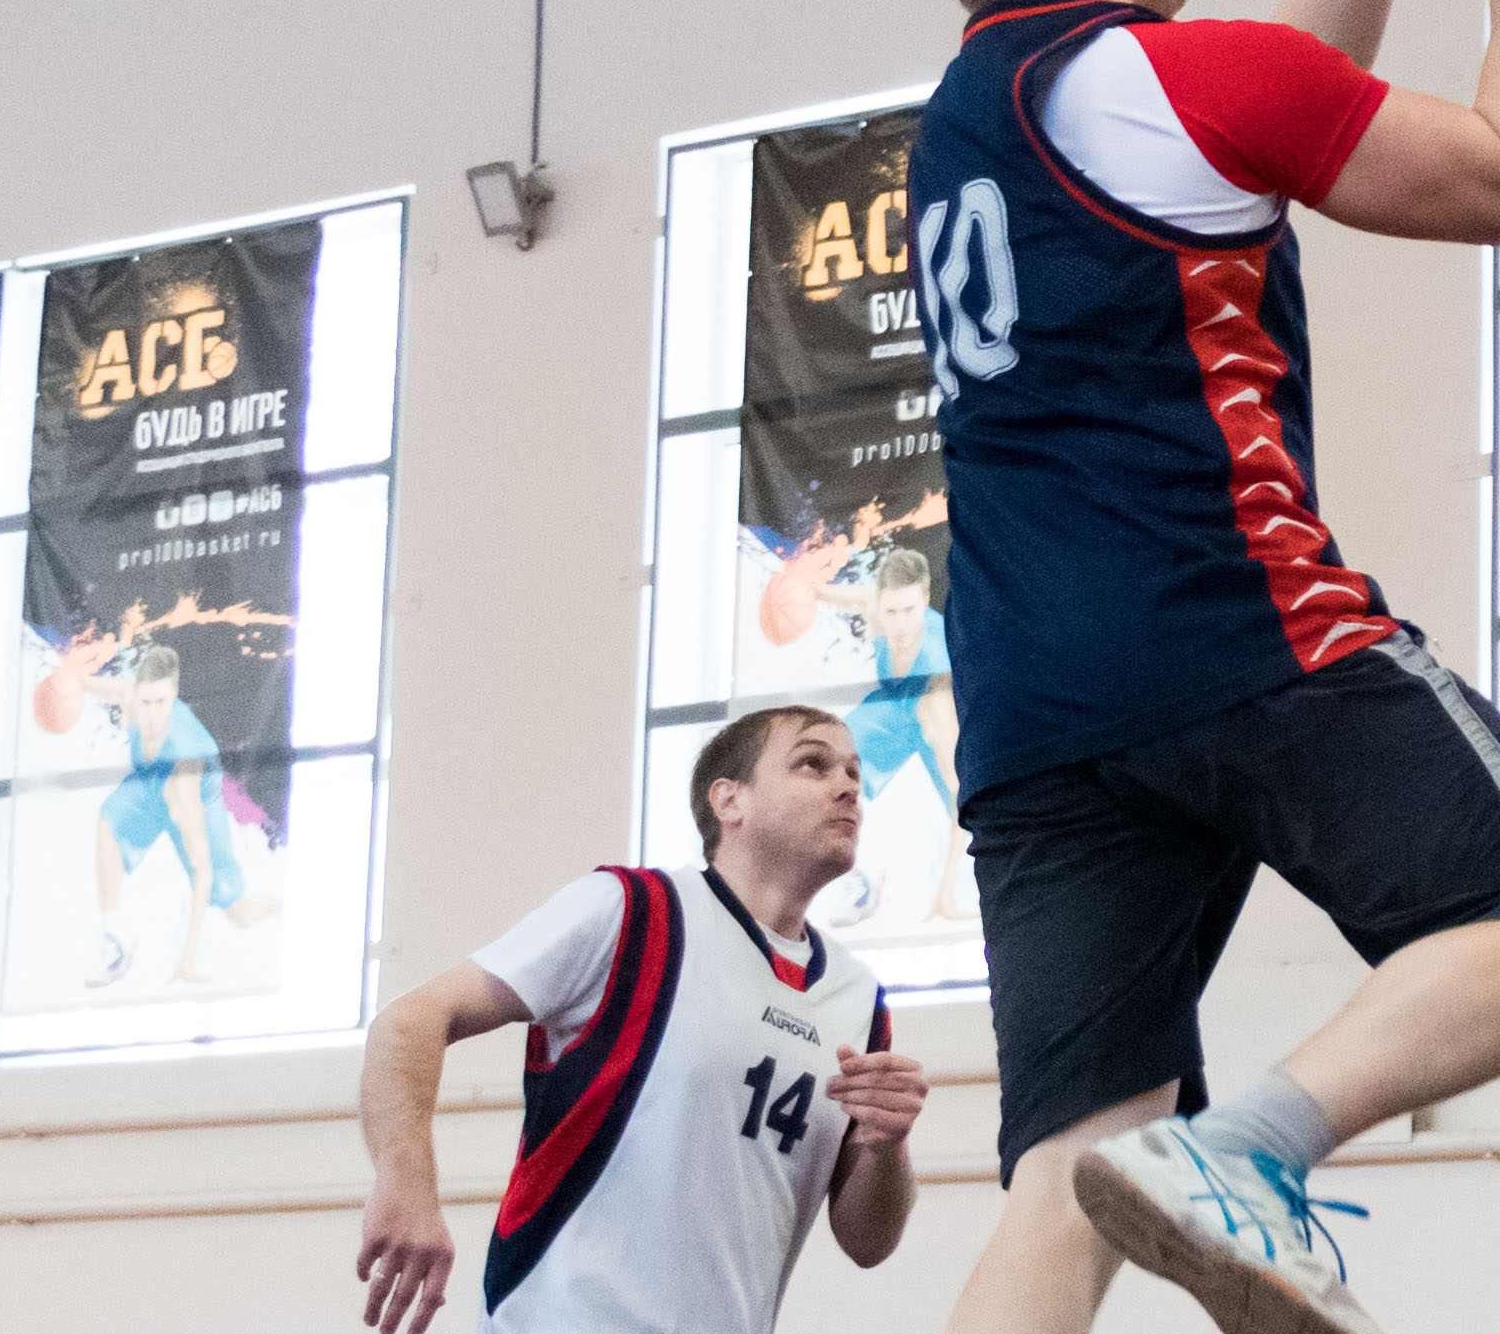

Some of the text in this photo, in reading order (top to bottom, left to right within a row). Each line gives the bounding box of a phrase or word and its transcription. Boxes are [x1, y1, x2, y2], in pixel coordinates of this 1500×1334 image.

[804, 190, 908, 287] АС
[80, 309, 238, 406] АСБ
[207, 400, 225, 439] В
[229, 389, 288, 435] ИГРЕ
[852, 430, 942, 467] pro100b
[740, 1055, 816, 1154] 14
